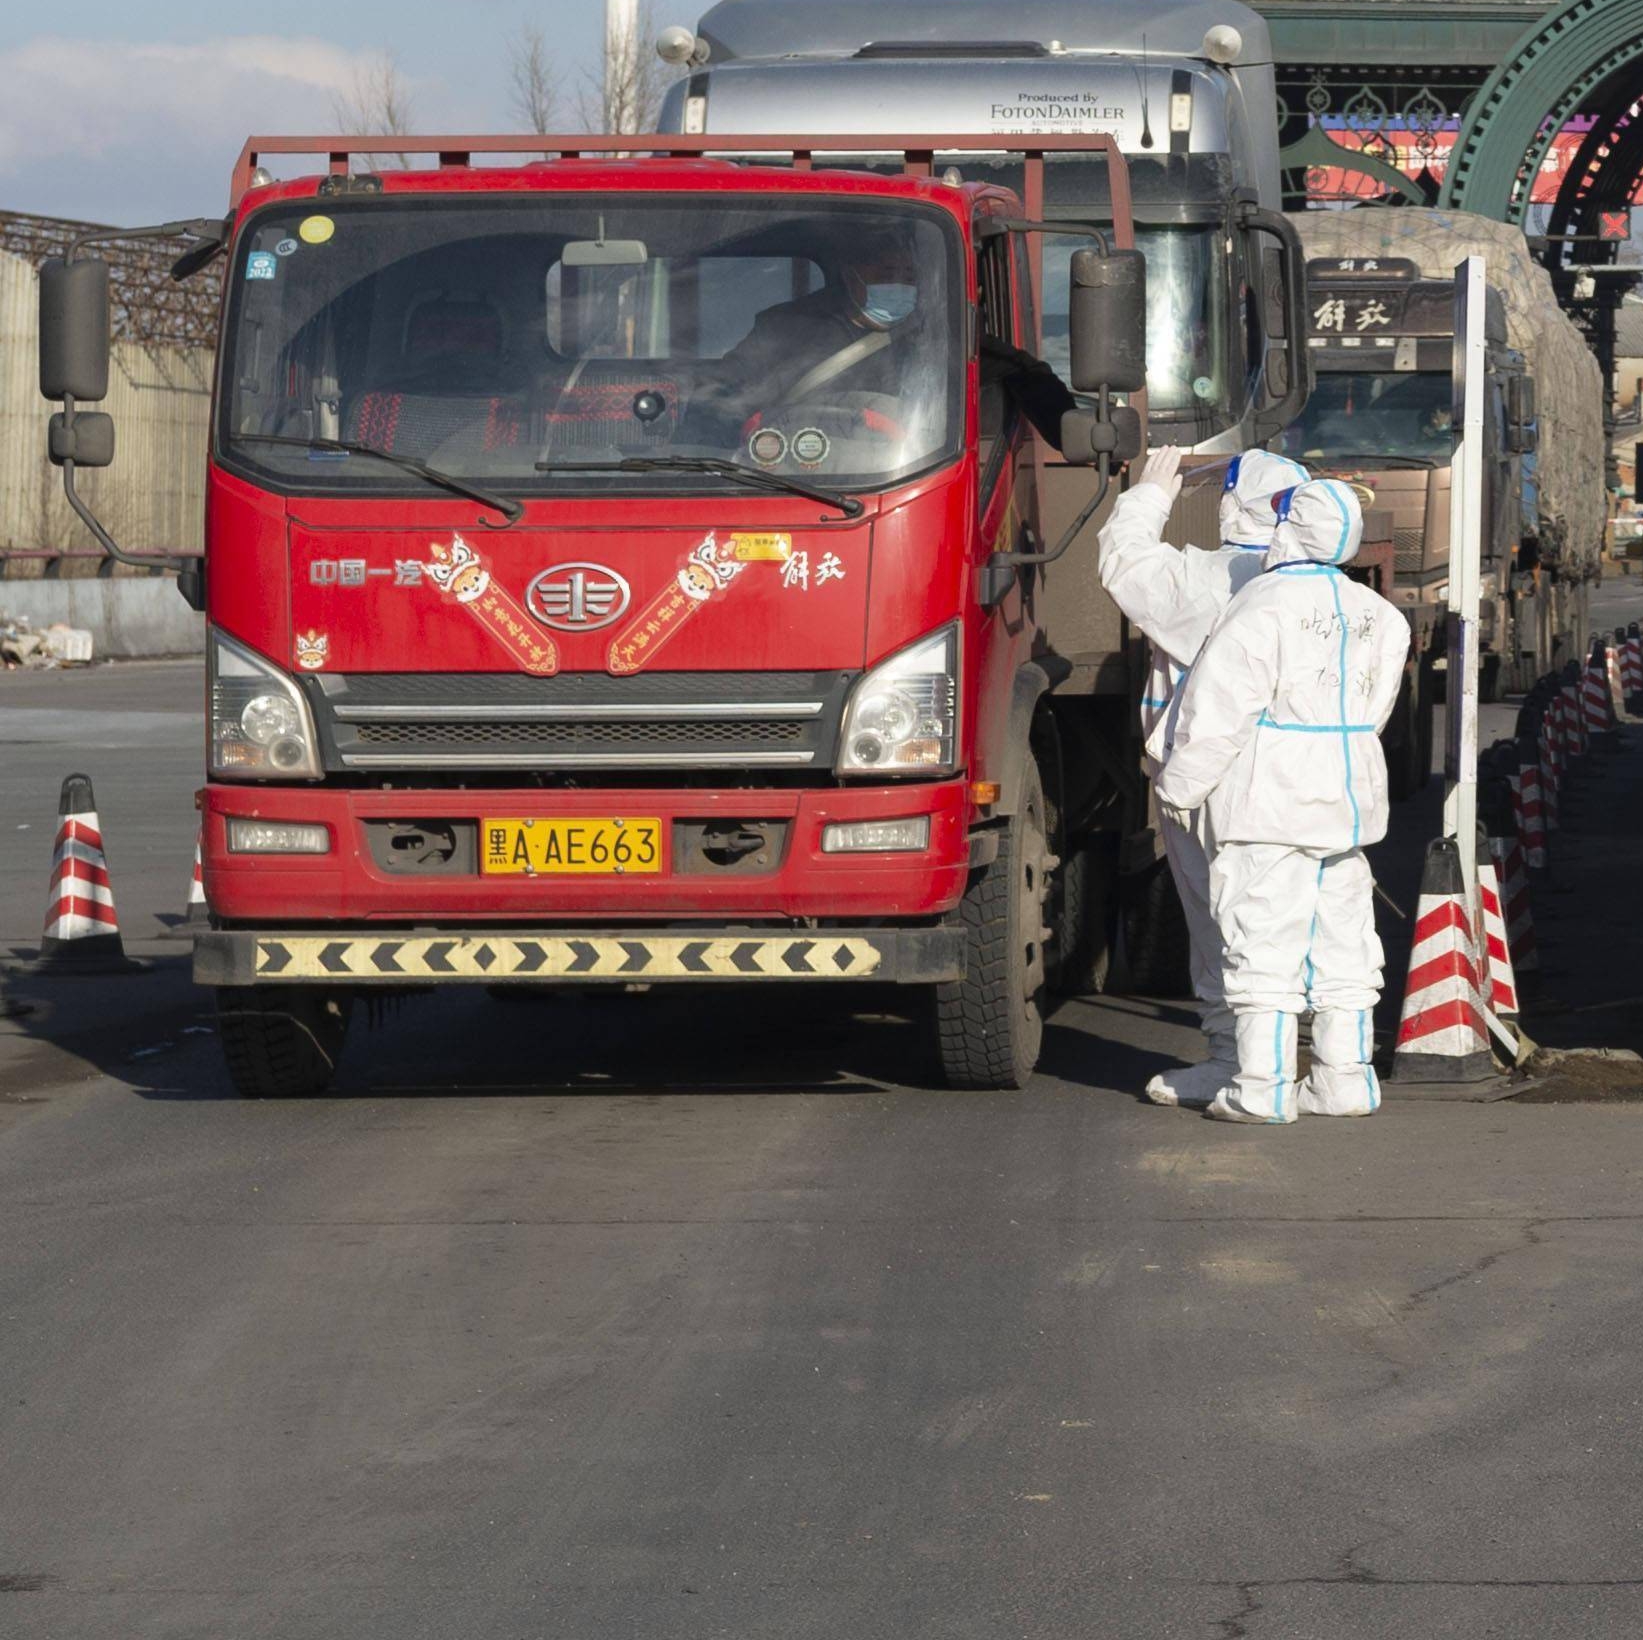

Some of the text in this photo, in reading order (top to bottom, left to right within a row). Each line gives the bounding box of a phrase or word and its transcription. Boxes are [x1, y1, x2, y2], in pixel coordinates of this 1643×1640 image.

[1018, 92, 1099, 104] Produced by
[310, 558, 423, 586] 中国一汽
